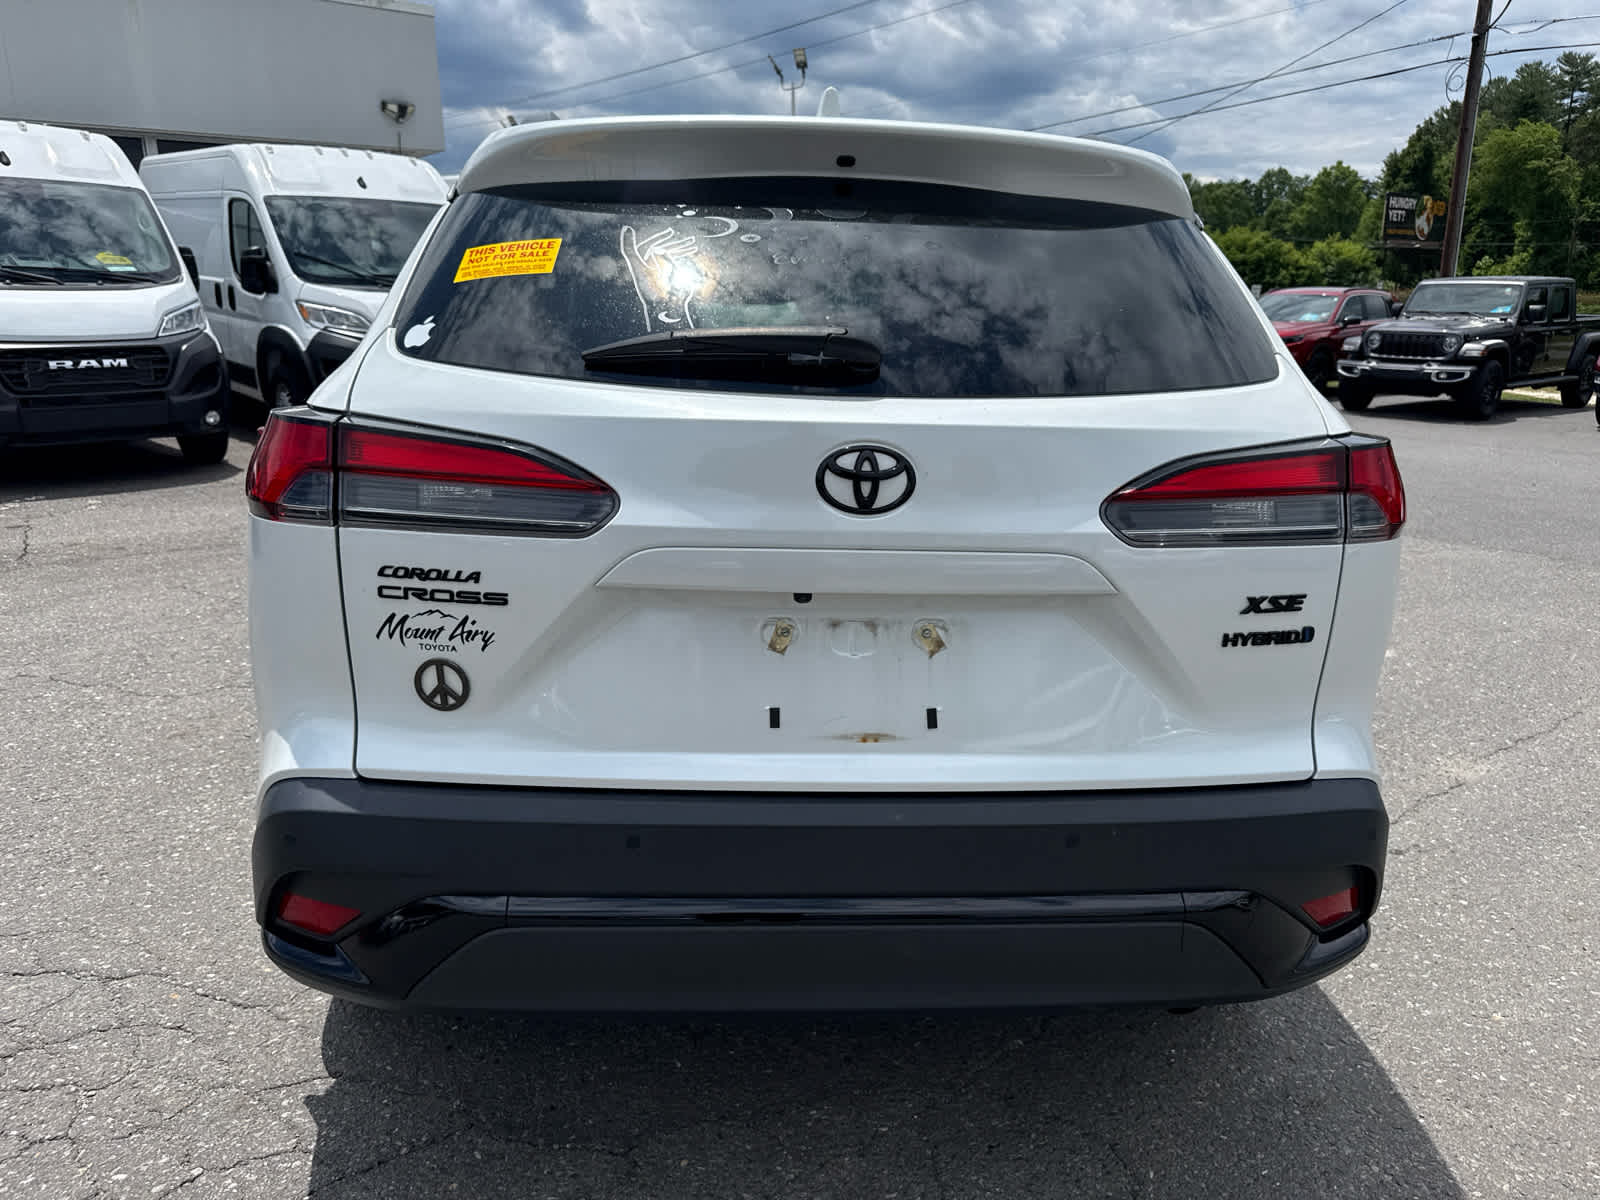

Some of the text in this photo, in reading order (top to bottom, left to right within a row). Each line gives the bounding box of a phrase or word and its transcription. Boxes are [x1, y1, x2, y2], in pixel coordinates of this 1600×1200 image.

[1389, 196, 1418, 209] HUNGRY
[1388, 209, 1406, 223] YET?
[468, 240, 556, 258] THIS VEHICLE
[468, 255, 490, 265] NOT
[493, 252, 516, 260] FOR
[520, 250, 550, 258] SALE
[48, 358, 128, 370] RAM
[377, 565, 481, 584] COROLLA
[377, 585, 508, 606] CROSS
[1240, 593, 1307, 614] XSE
[376, 612, 495, 652] Mount Airy
[1222, 630, 1301, 647] HYBRID
[419, 643, 457, 652] TOYOTA
